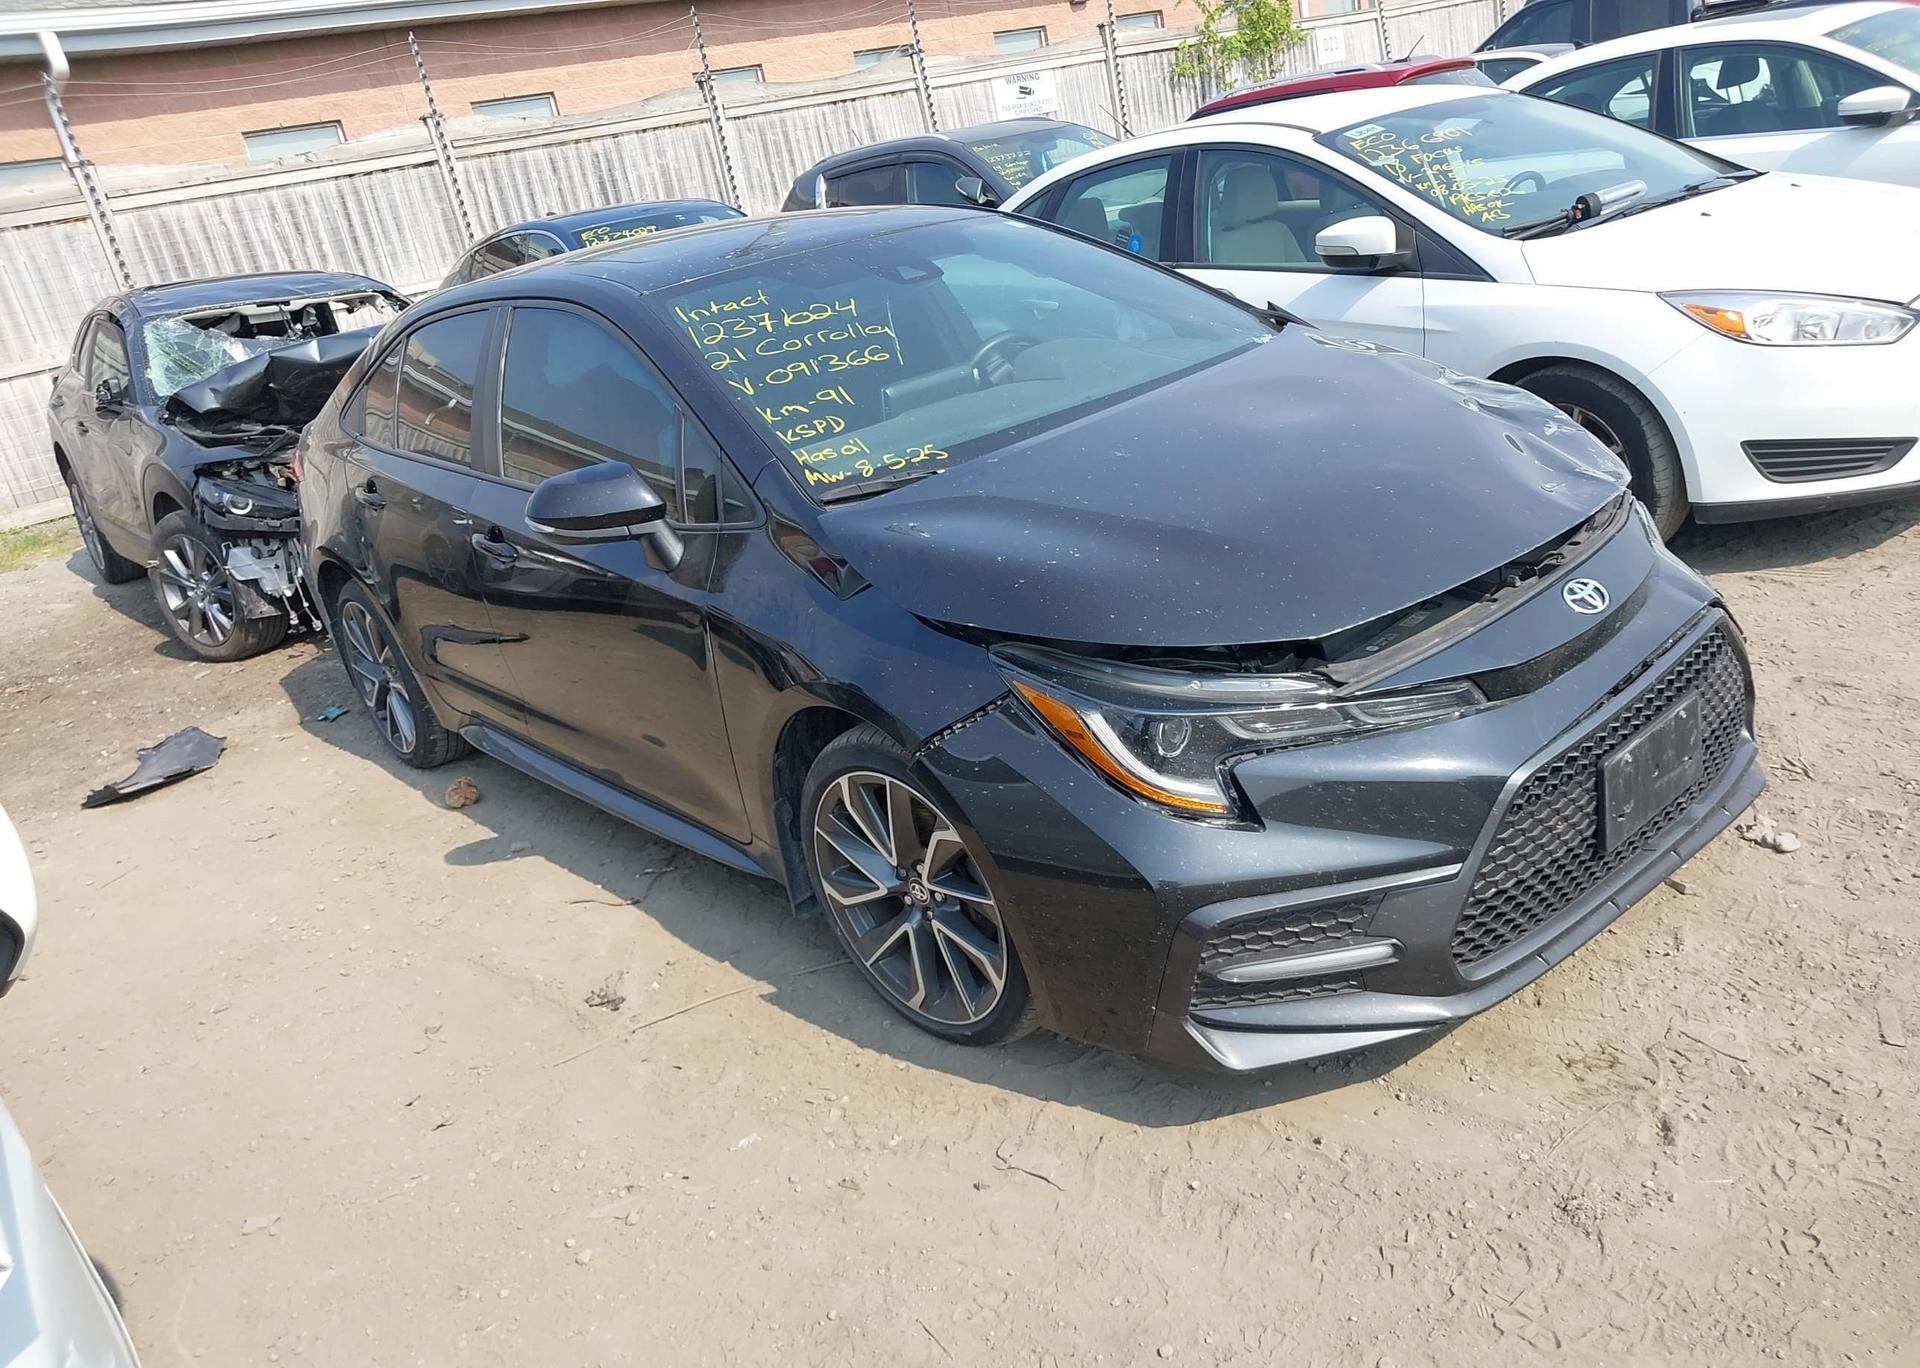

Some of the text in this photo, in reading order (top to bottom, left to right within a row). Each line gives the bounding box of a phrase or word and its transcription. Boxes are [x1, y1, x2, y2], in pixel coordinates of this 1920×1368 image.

[1004, 73, 1040, 85] WARNING
[1349, 133, 1396, 150] ECO
[581, 227, 610, 240] ECO
[675, 289, 769, 322] Intact
[704, 346, 747, 370] 21
[791, 449, 838, 466] Has
